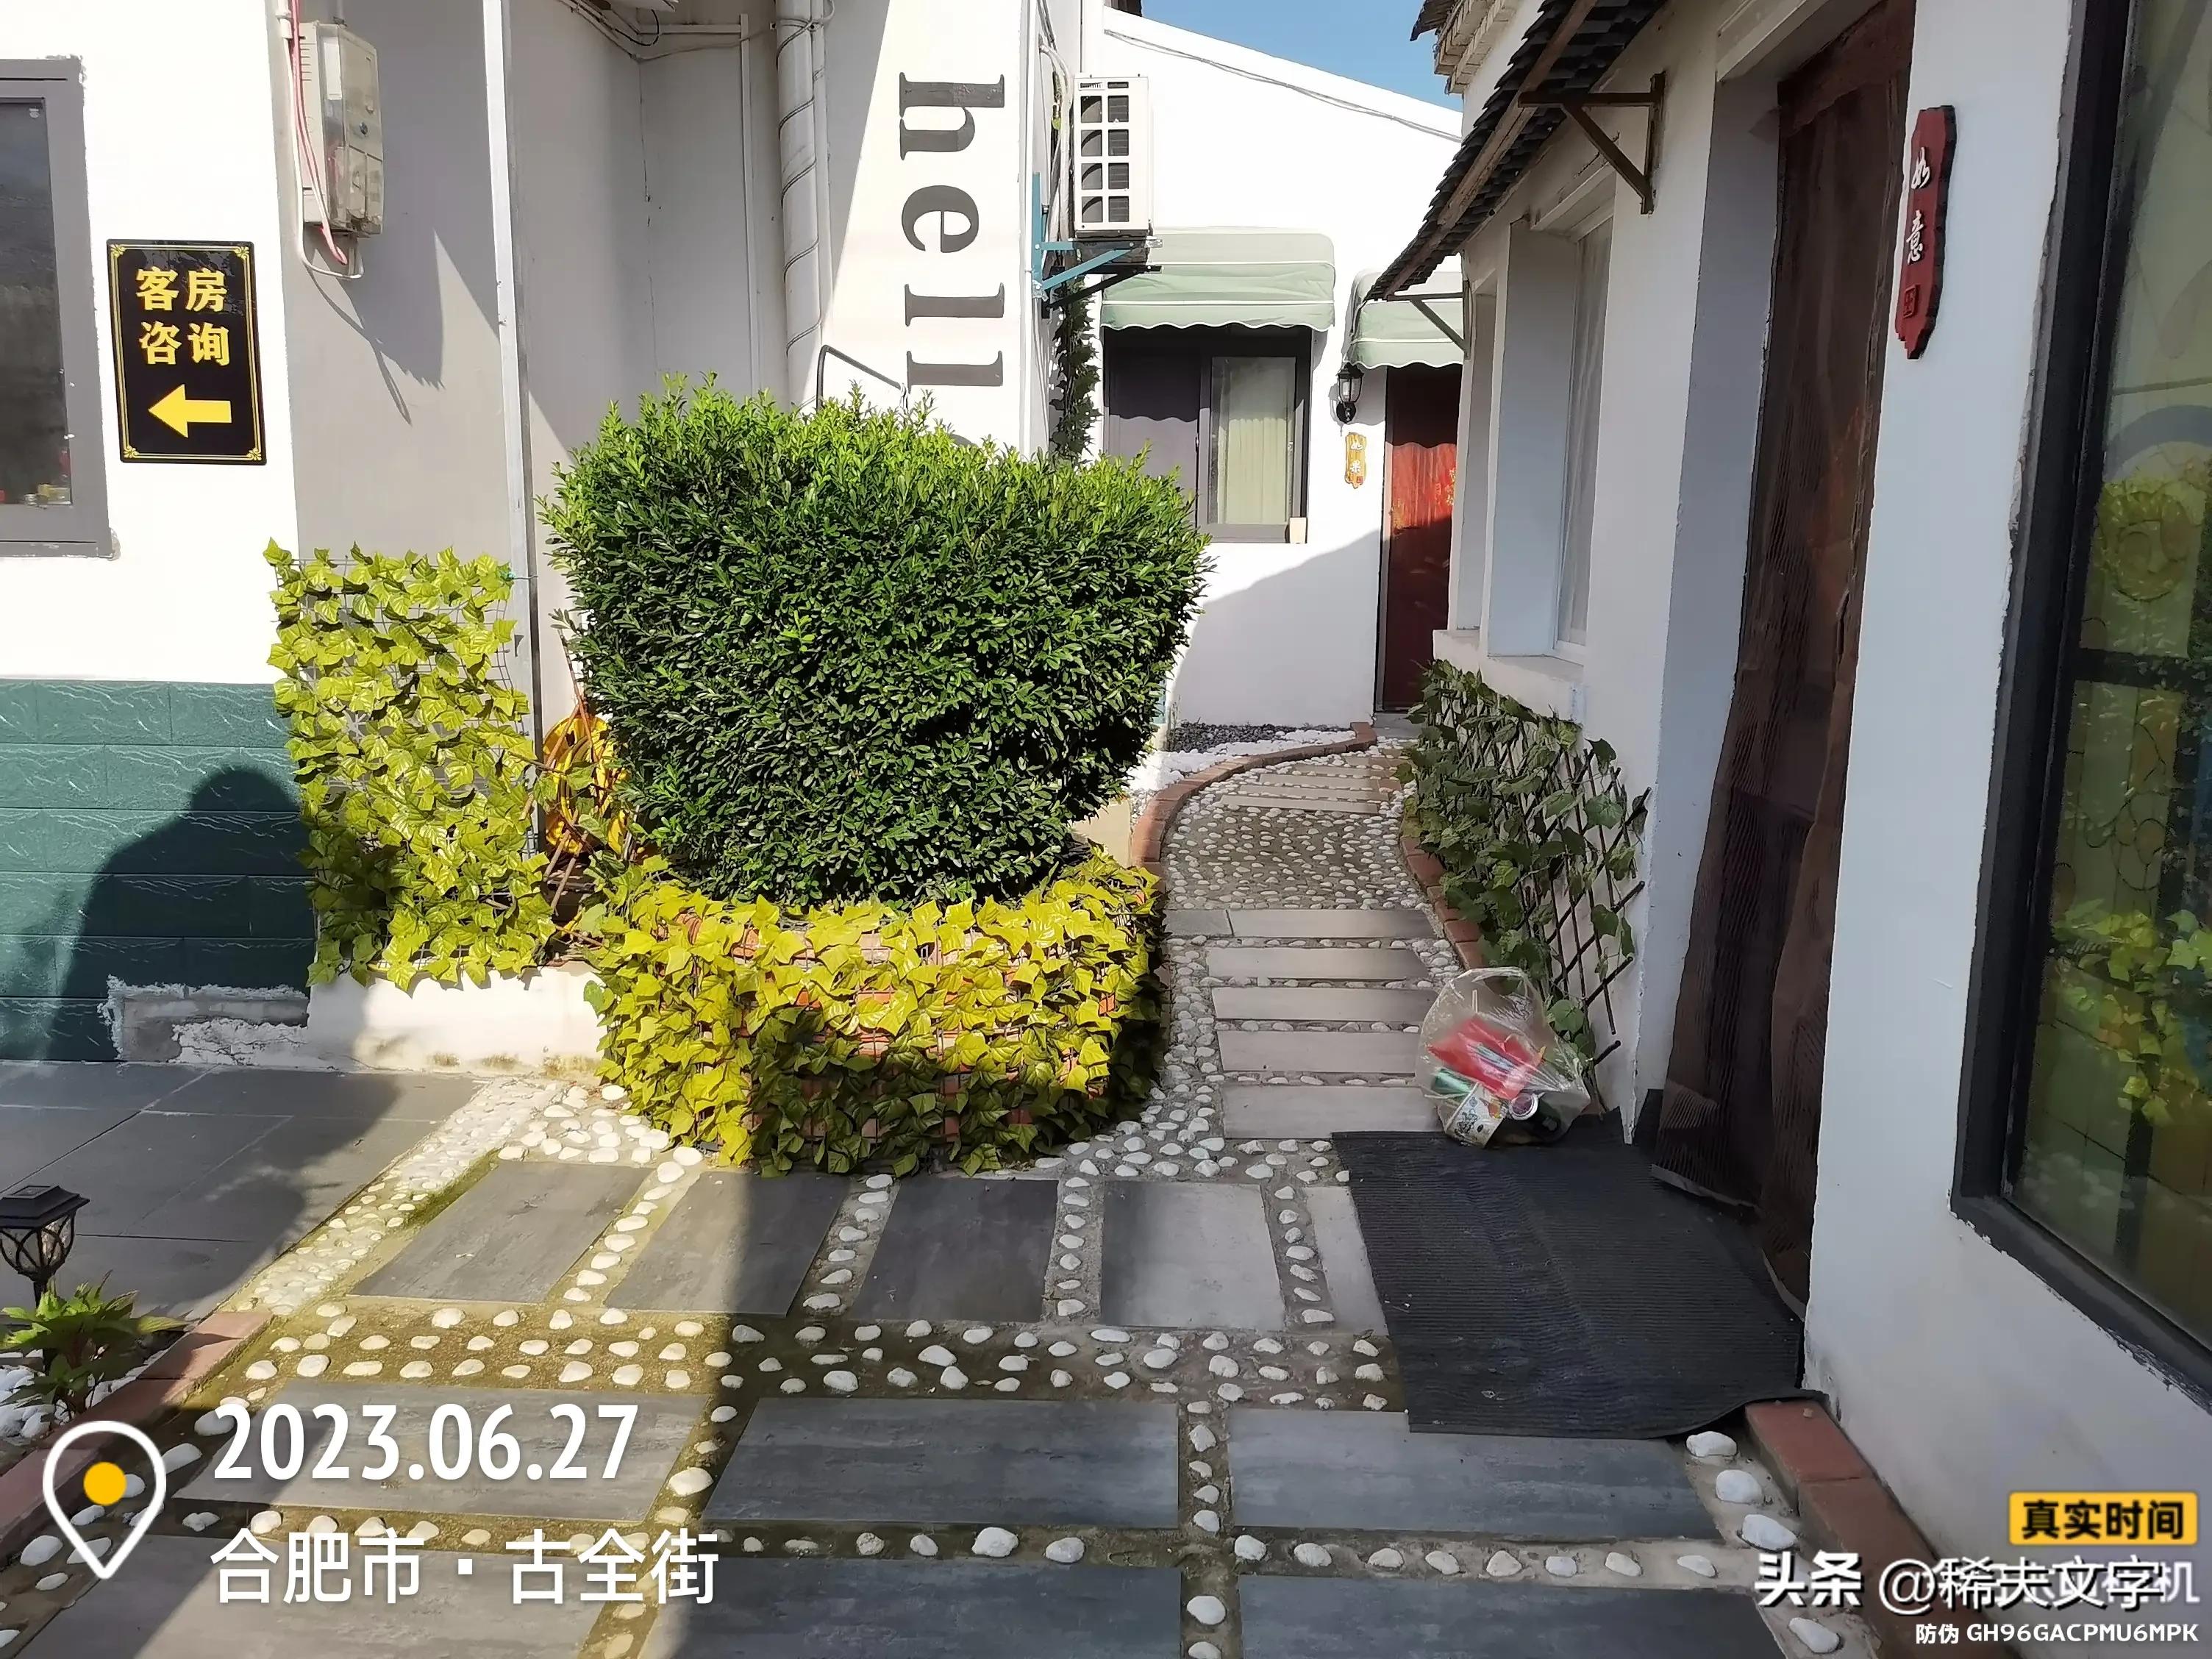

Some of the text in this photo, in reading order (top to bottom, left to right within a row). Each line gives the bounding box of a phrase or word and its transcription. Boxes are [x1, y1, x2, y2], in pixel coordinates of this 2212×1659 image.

[899, 71, 1005, 445] hell
[135, 266, 228, 312] 客房
[139, 321, 230, 366] 咨询
